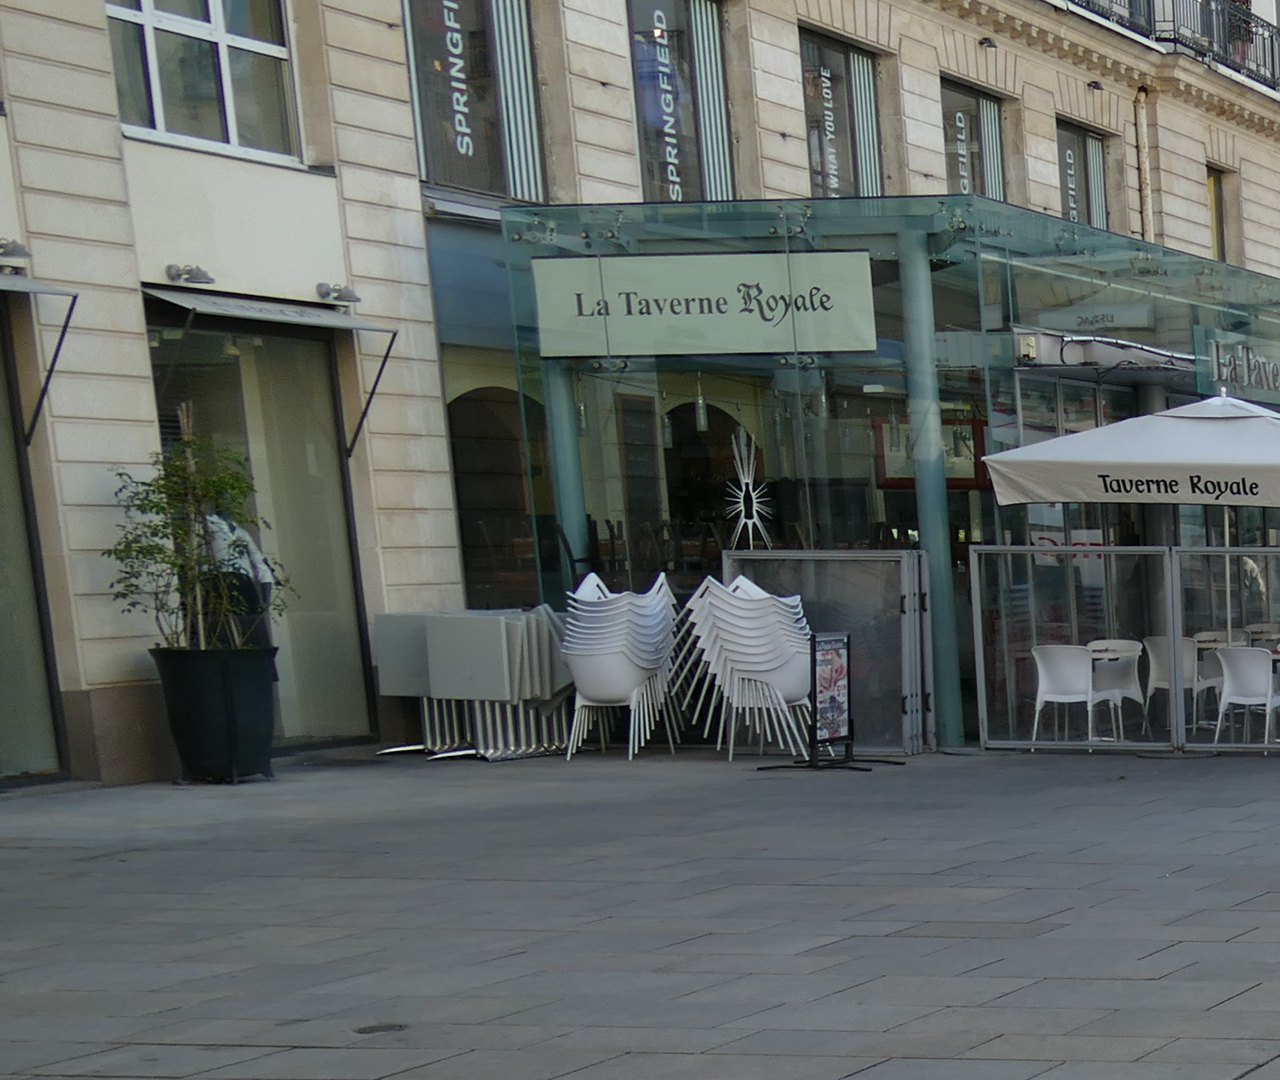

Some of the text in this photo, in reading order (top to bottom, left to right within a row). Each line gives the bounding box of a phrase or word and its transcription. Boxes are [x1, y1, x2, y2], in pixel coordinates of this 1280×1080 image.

[653, 9, 683, 202] SPRINGFIELD
[820, 66, 834, 109] LOVE
[824, 111, 836, 141] YOU
[827, 147, 840, 189] WHAT
[574, 282, 834, 328] La Taverne Royale
[1210, 339, 1238, 384] La
[1097, 474, 1259, 501] Taverne Royale
